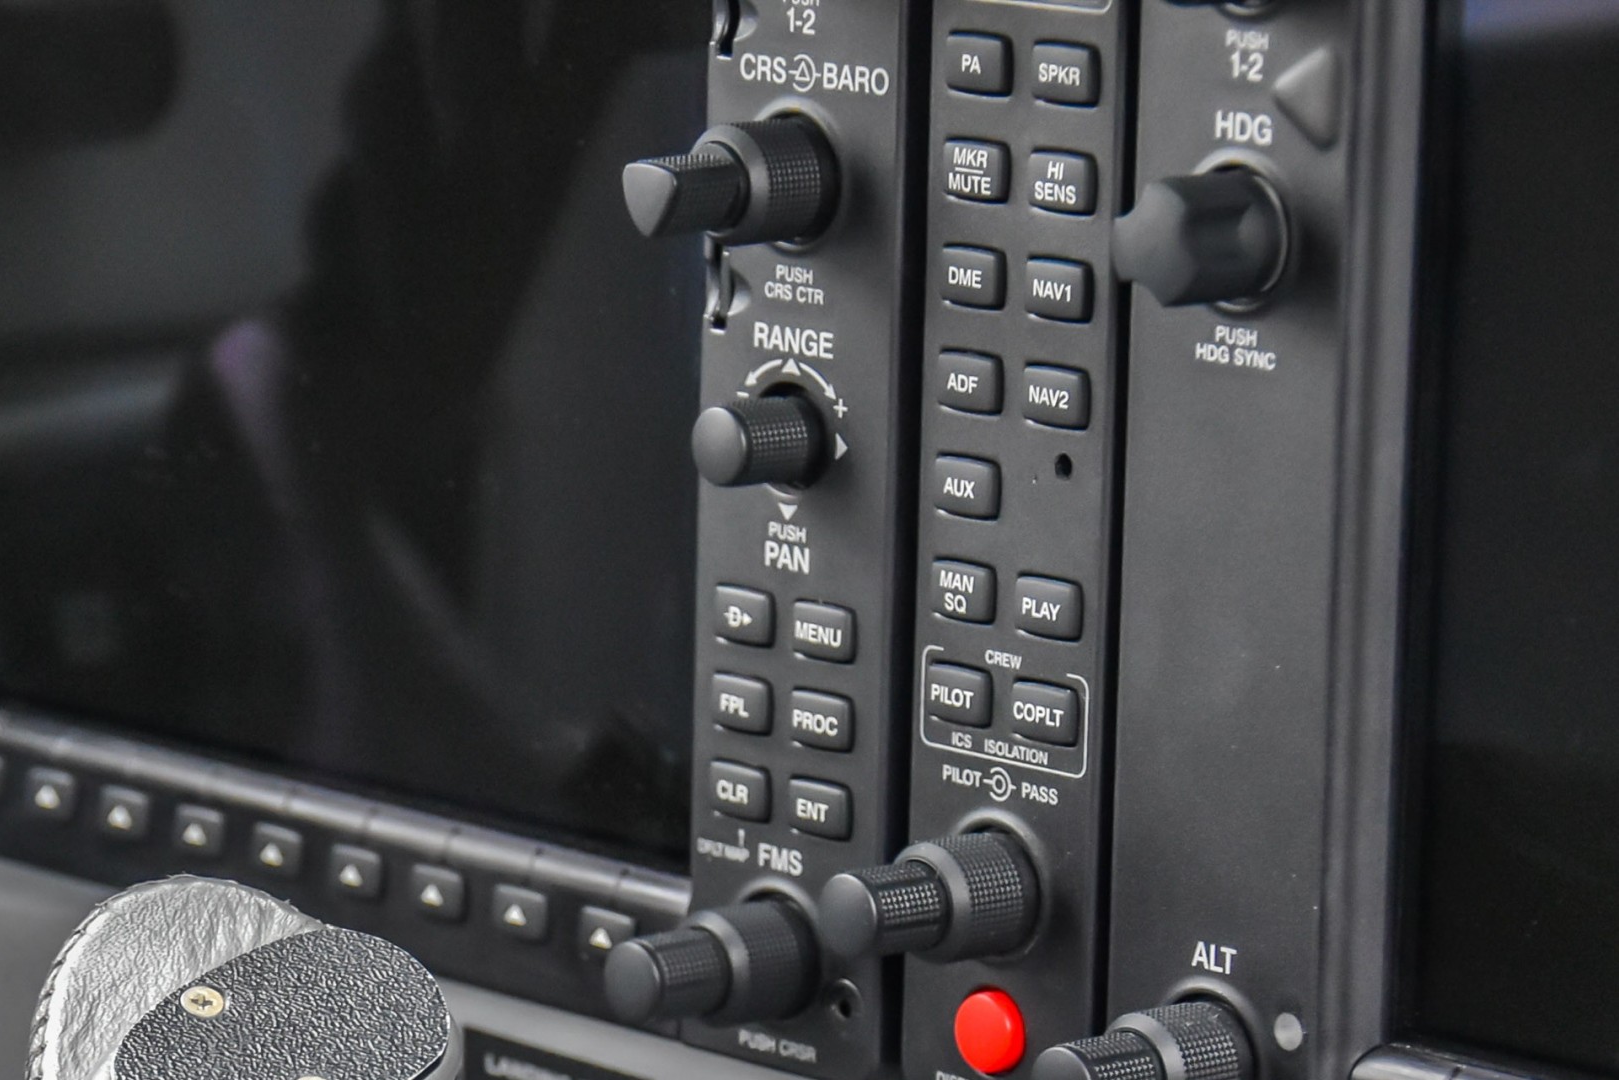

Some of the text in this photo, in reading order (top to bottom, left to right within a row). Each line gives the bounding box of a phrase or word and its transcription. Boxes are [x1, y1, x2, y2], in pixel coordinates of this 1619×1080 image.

[786, 6, 816, 35] 1-2
[1225, 29, 1269, 51] PUSH
[739, 53, 890, 96] CRS BARO
[961, 54, 981, 75] PA
[1038, 62, 1080, 87] SPKR
[1230, 52, 1263, 83] 1-2
[1215, 110, 1272, 146] HDG
[953, 147, 988, 169] MKR
[1047, 161, 1064, 181] HI
[948, 172, 992, 197] MUTE
[1034, 182, 1077, 205] SENS
[775, 264, 814, 285] PUSH
[948, 266, 982, 289] DME
[764, 281, 824, 306] CRS CTR
[1033, 279, 1072, 302] NAV1
[753, 322, 834, 359] RANGE
[1215, 326, 1257, 348] PUSH
[1196, 343, 1276, 371] HDG SYNC
[947, 373, 978, 394] ADF
[1028, 385, 1069, 410] NAV2
[943, 477, 975, 498] AUX
[768, 521, 806, 543] PUSH
[764, 540, 810, 574] PAN
[939, 570, 974, 593] MAN
[944, 592, 967, 615] SQ
[1021, 598, 1060, 621] PLAY
[794, 620, 842, 647] MENU
[984, 649, 1022, 670] CREW
[719, 692, 749, 718] FPL
[931, 683, 973, 710] PILOT
[792, 709, 838, 738] PROC
[1013, 701, 1064, 728] COPLT
[951, 732, 1049, 766] ICS ISOLATION
[716, 778, 748, 805] CLR
[942, 764, 1058, 806] PILOT PASS
[796, 798, 828, 823] ENT
[758, 842, 803, 877] FMS
[1191, 941, 1237, 975] ALT
